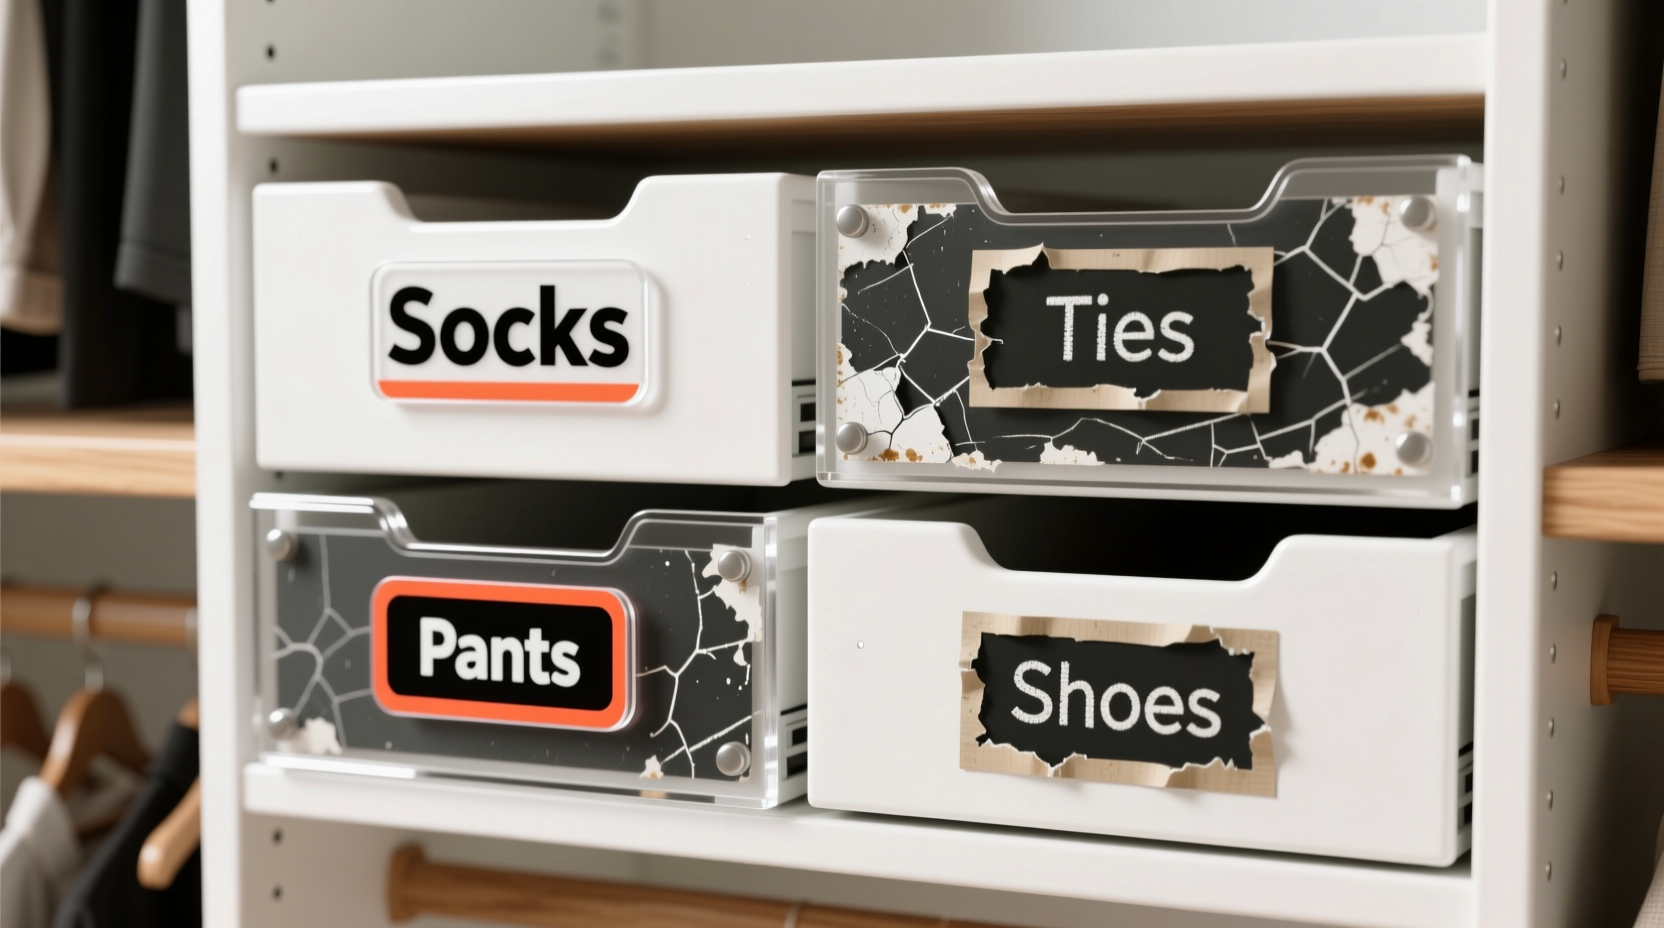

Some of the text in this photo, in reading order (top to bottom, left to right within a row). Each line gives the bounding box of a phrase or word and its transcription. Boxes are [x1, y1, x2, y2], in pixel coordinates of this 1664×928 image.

[388, 285, 630, 368] Socks
[1046, 294, 1195, 363] Ties
[419, 616, 581, 688] Pants
[1010, 660, 1222, 738] Shoes
